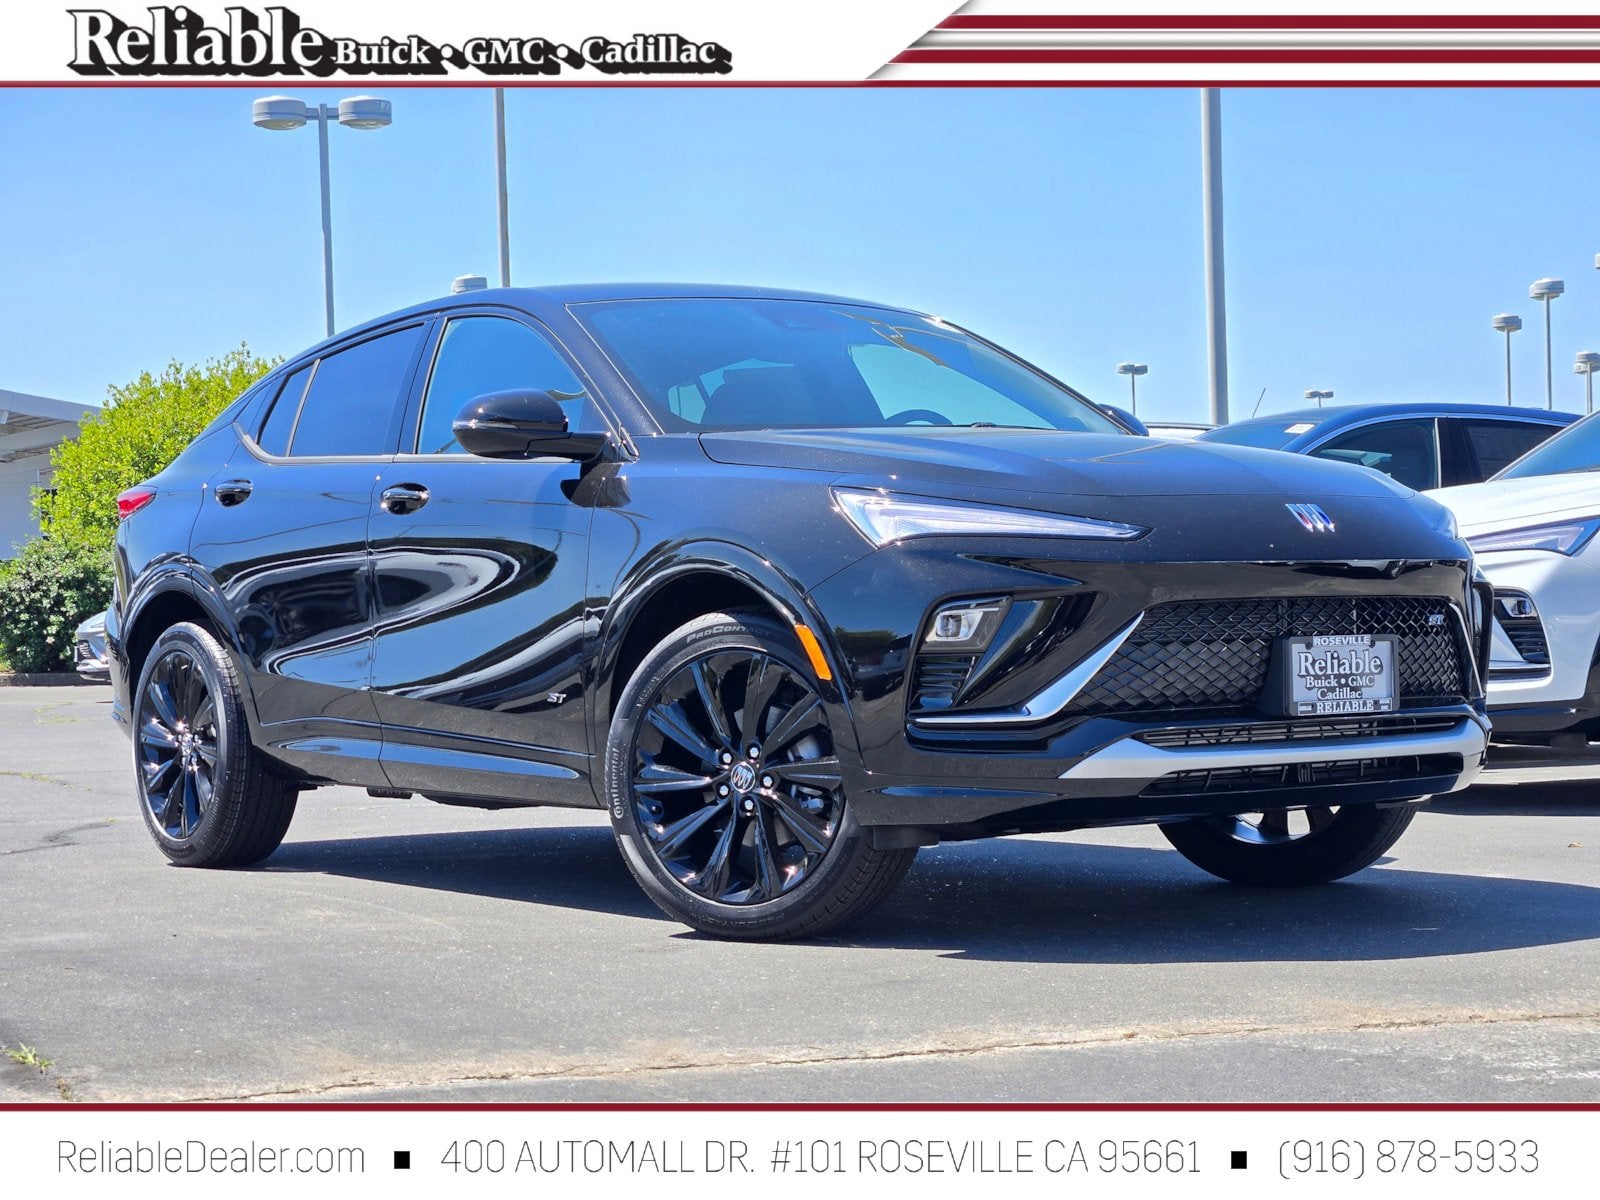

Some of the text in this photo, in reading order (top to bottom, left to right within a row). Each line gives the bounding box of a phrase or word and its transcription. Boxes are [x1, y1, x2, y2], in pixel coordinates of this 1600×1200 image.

[1313, 636, 1372, 646] ROSEVILLE
[1299, 651, 1384, 676] Reliable
[1306, 675, 1375, 689] Buick GMC
[547, 693, 567, 704] ST
[1317, 689, 1363, 700] Cadillac
[1316, 701, 1375, 714] RELIABLE
[612, 747, 624, 819] Continental
